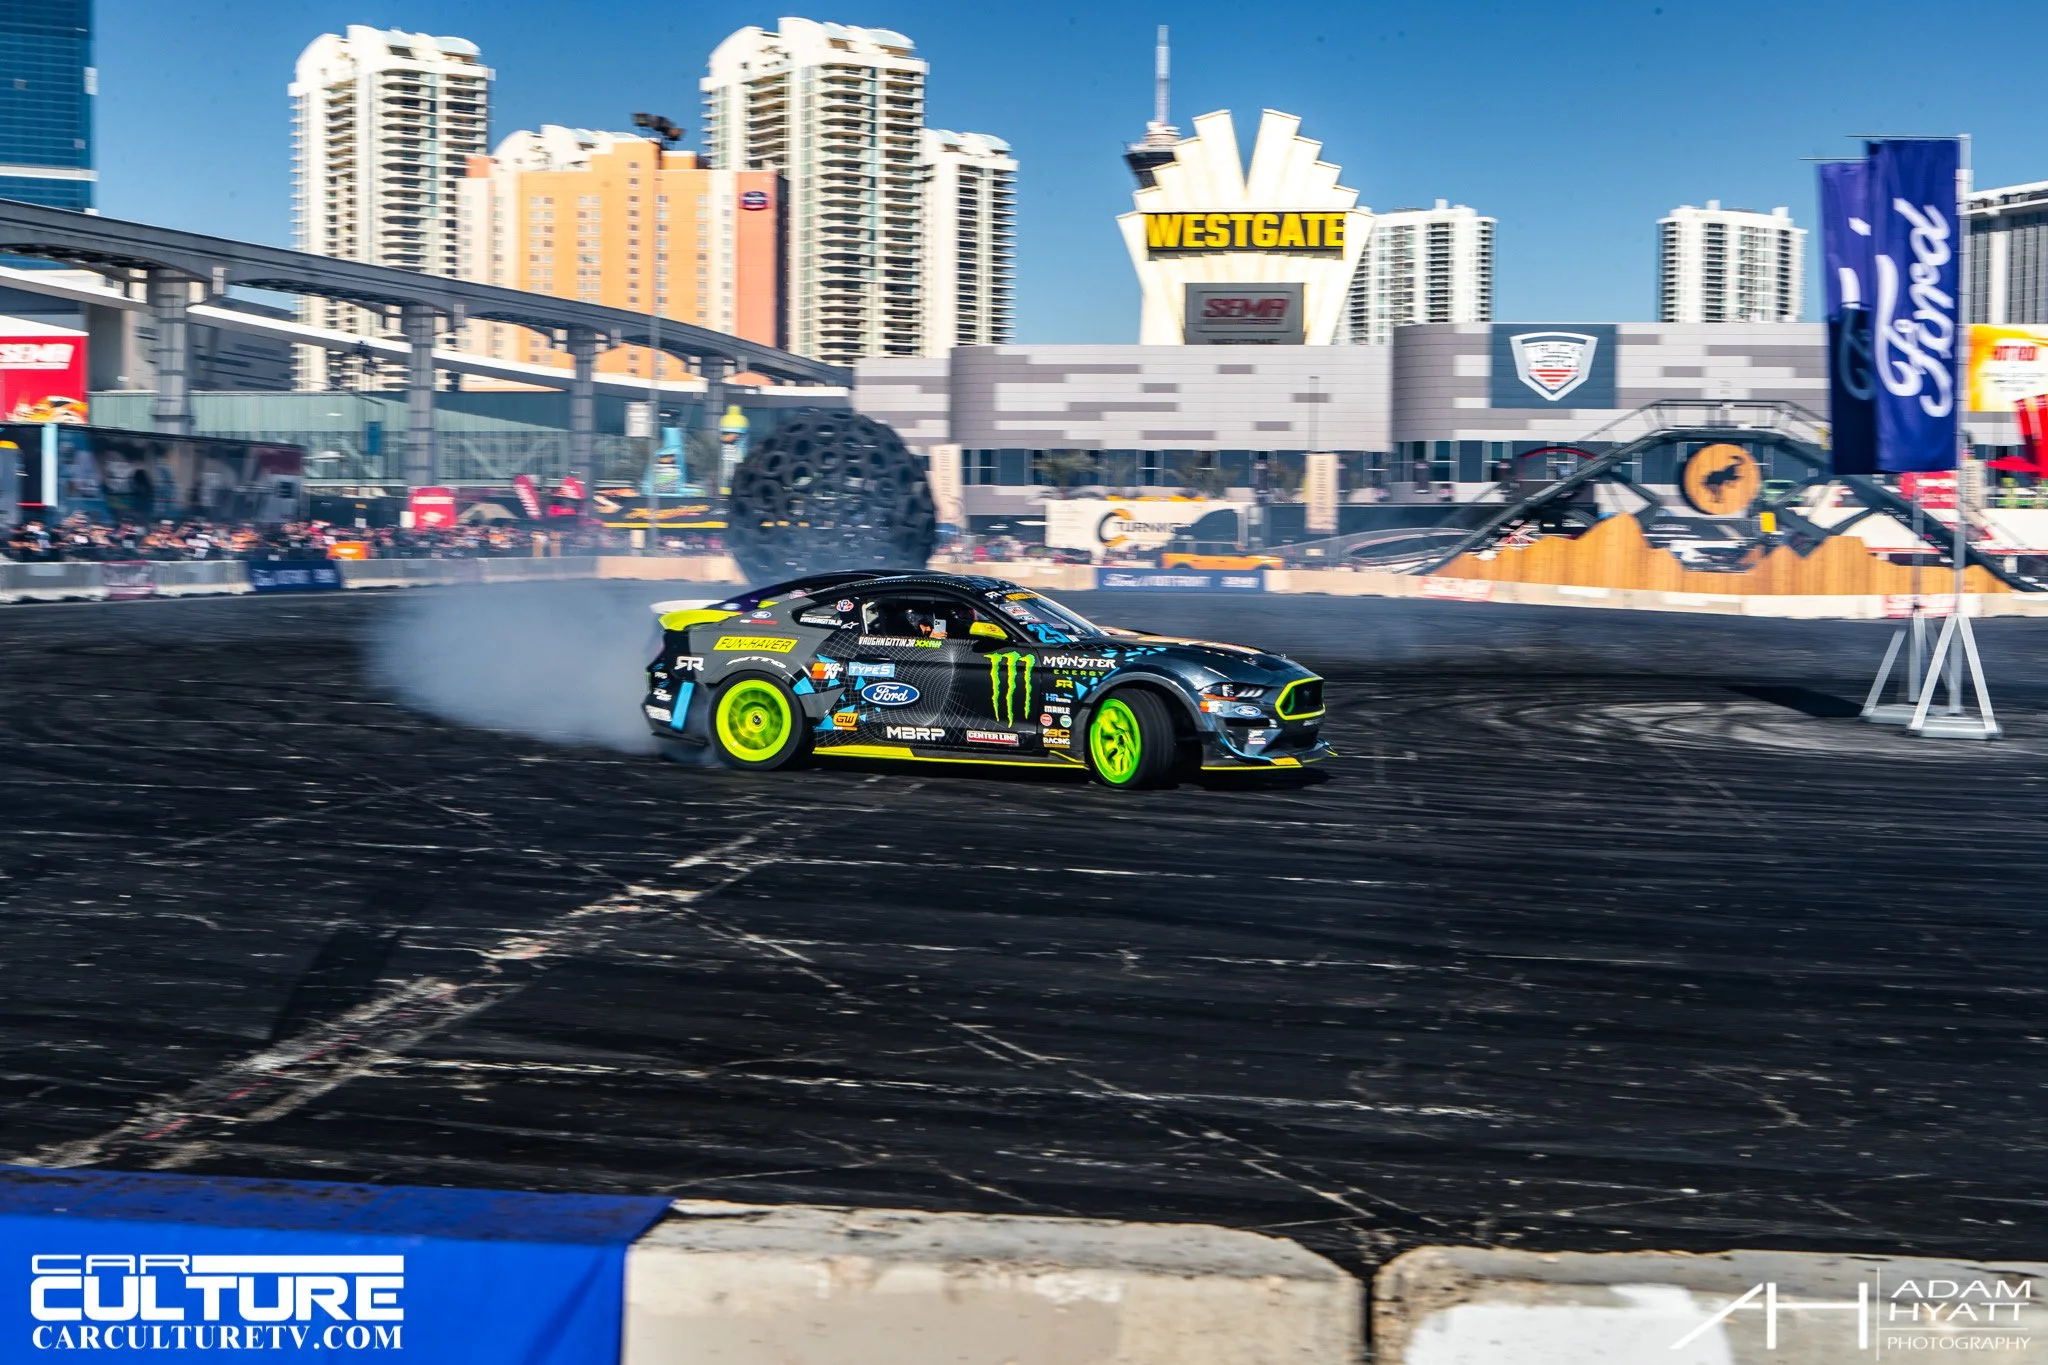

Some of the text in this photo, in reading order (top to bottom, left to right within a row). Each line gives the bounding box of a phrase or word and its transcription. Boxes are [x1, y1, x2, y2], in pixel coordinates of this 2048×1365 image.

[1145, 212, 1346, 248] WESTGATE
[1200, 298, 1289, 317] SEMA
[1874, 197, 1955, 418] Ford
[1027, 623, 1071, 644] 25
[720, 638, 792, 650] FUN-HAVER
[859, 636, 885, 646] VAUGHN
[1043, 655, 1116, 669] MONSTER
[873, 684, 908, 701] Ford
[886, 726, 945, 740] MBRP
[968, 732, 999, 740] CENTER
[1043, 737, 1070, 745] RACING
